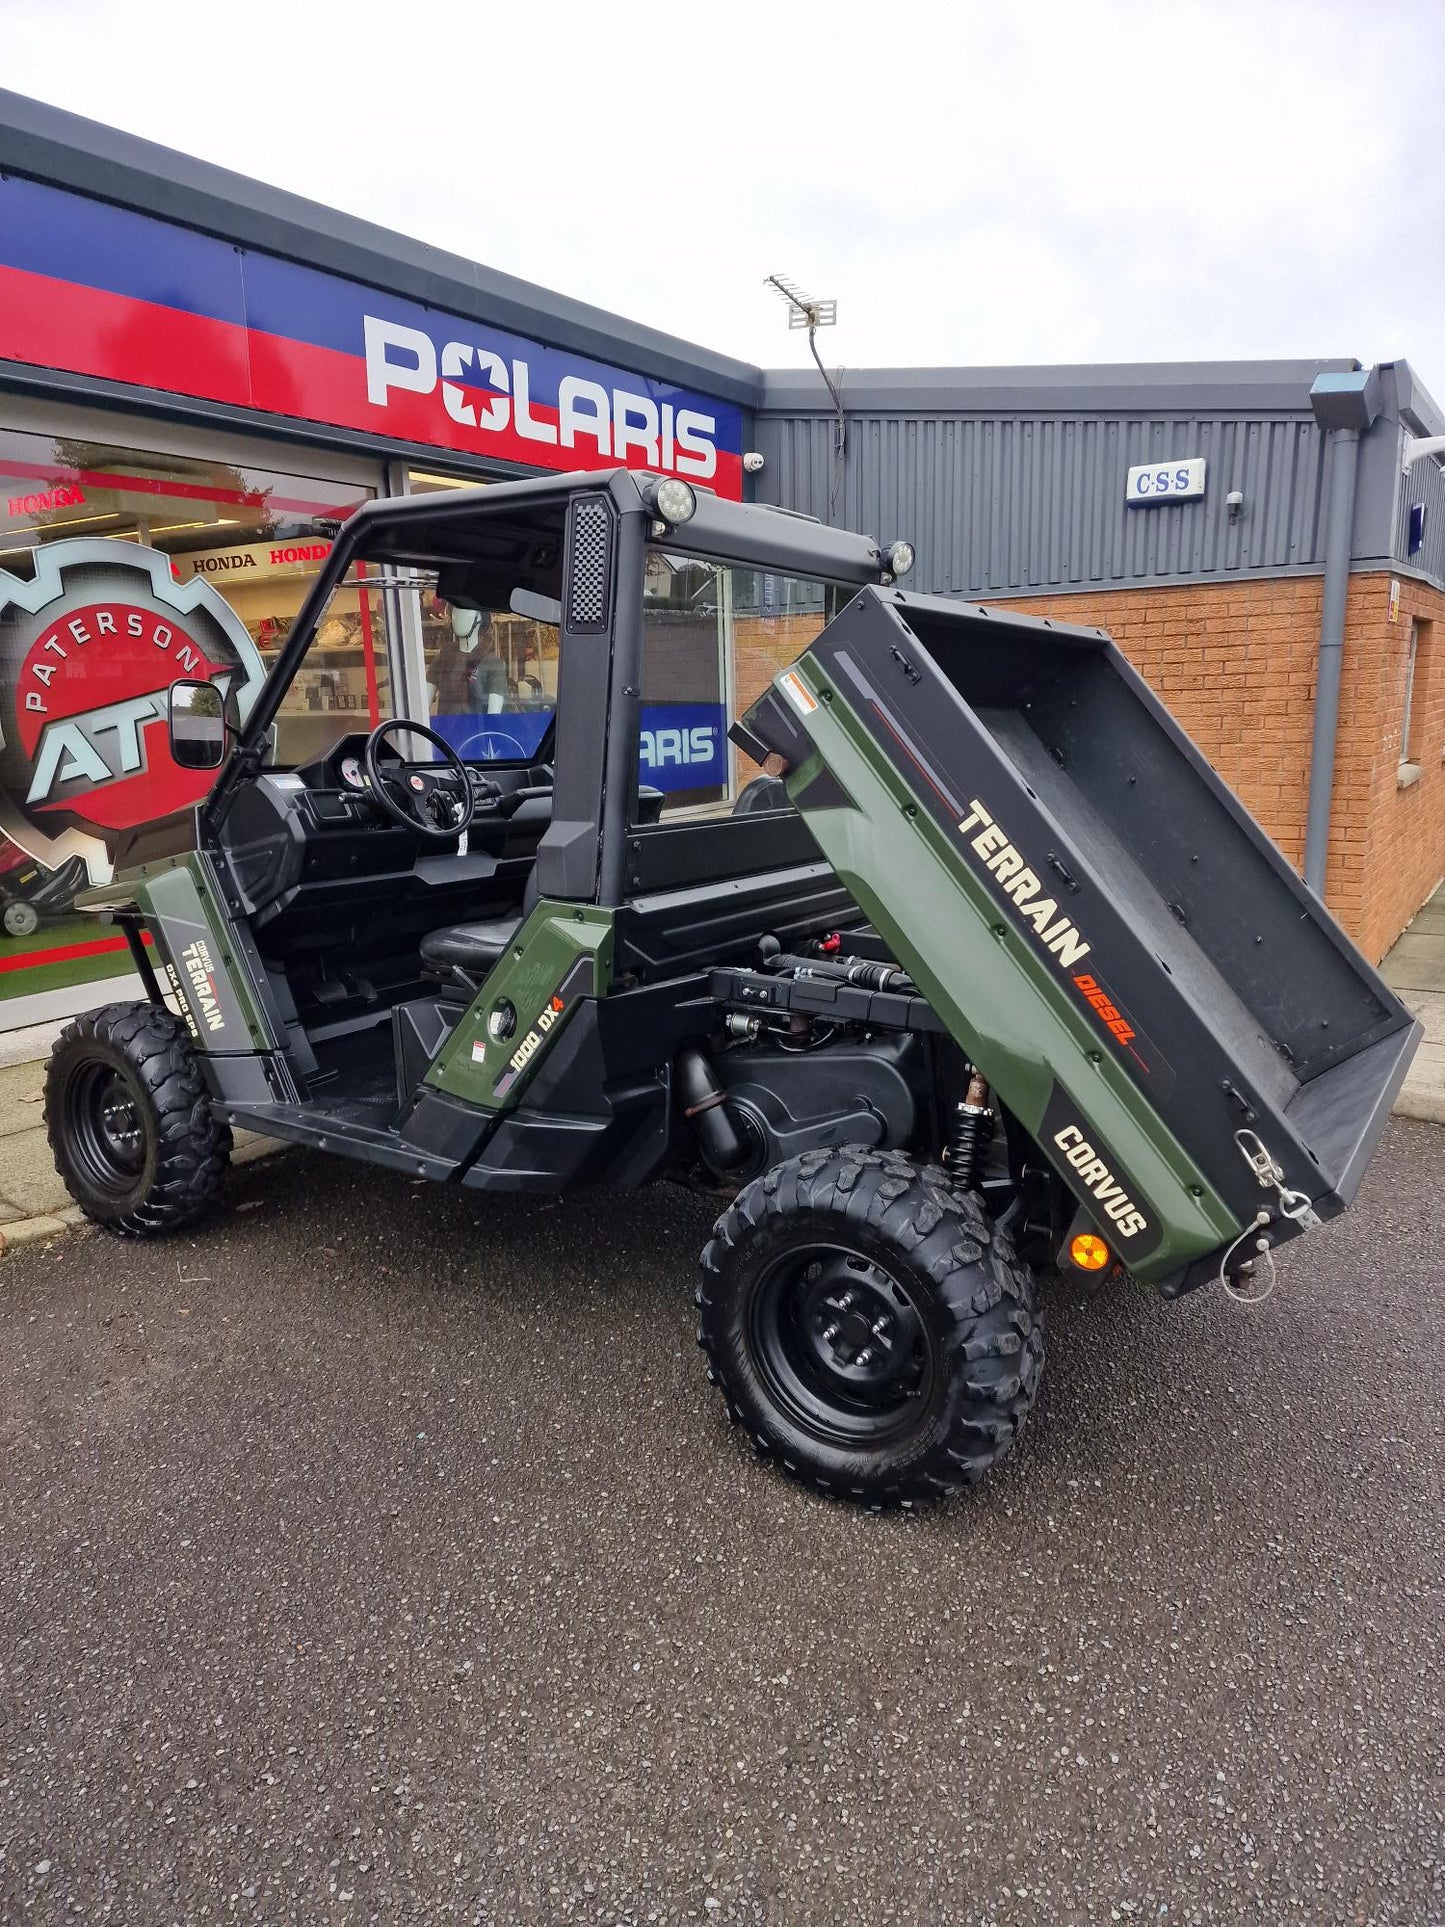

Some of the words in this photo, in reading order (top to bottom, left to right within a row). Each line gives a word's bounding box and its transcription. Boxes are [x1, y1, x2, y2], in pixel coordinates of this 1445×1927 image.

[363, 314, 717, 479] POLARIS
[7, 484, 86, 517] HONDA
[192, 553, 257, 573] HONDA
[26, 611, 199, 713] PATERSON
[26, 675, 232, 804] AT
[196, 940, 214, 973] CORVUS
[958, 798, 1091, 969] TERRAIN
[1072, 973, 1137, 1047] DIESEL
[175, 988, 189, 1013] PRO
[186, 1014, 198, 1037] EPS
[182, 943, 225, 1031] TERRAIN
[510, 1031, 540, 1072] 1000
[538, 996, 564, 1031] DX4
[1053, 1124, 1148, 1238] CORVUS
